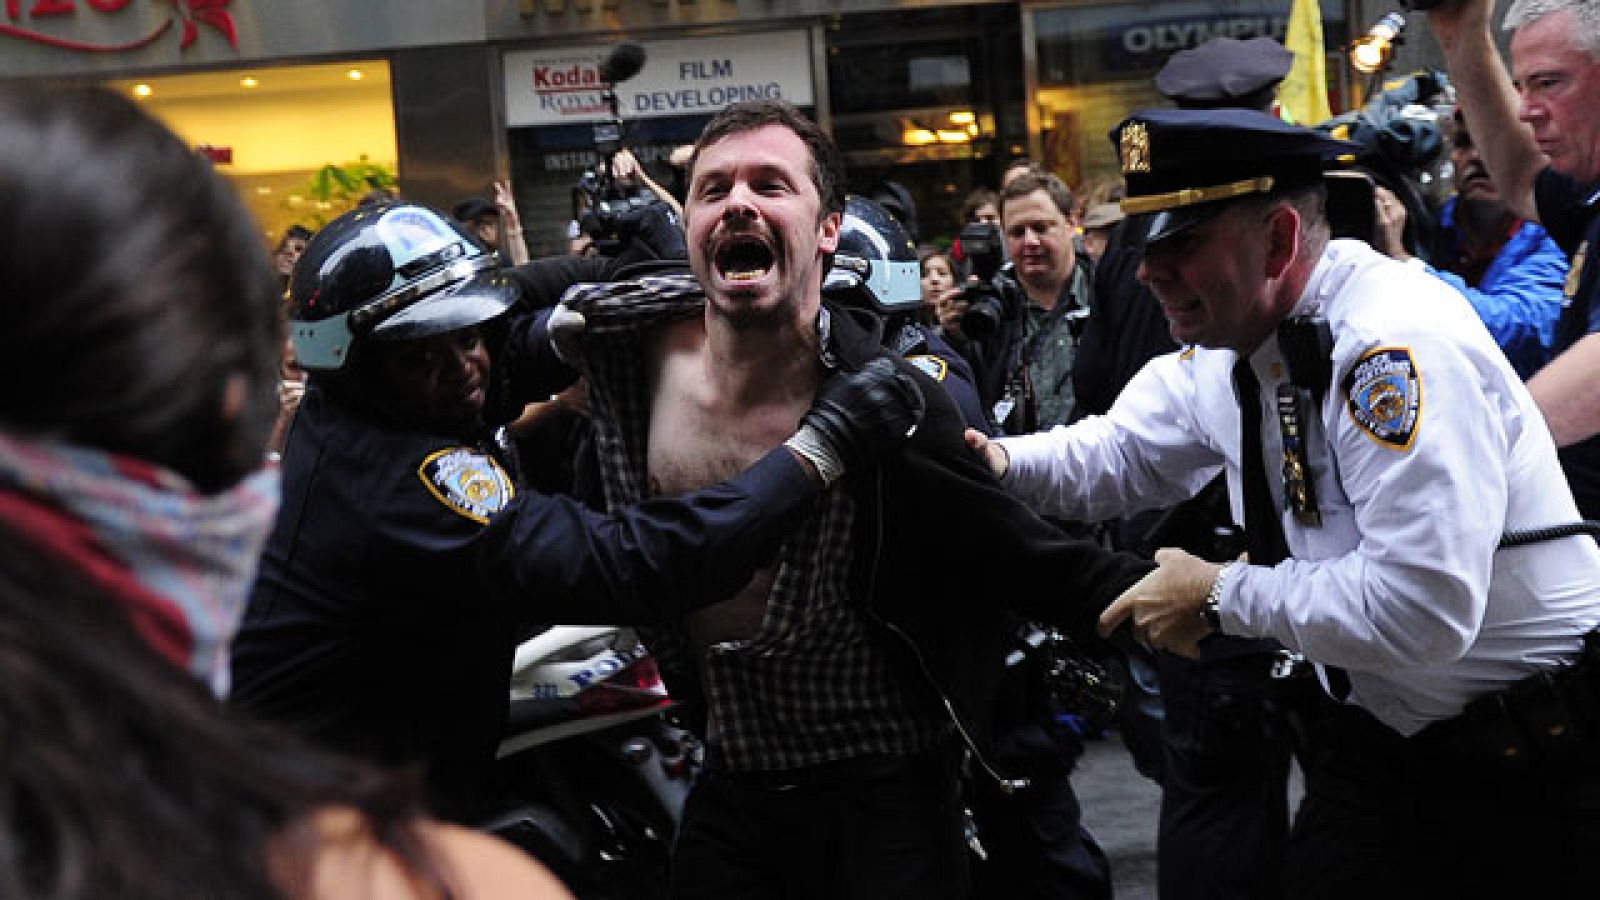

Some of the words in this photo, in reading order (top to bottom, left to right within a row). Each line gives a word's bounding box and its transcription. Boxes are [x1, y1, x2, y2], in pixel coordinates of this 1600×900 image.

[1123, 18, 1286, 53] OLYMPU
[679, 59, 733, 80] FILM
[634, 82, 781, 111] DEVELOPING
